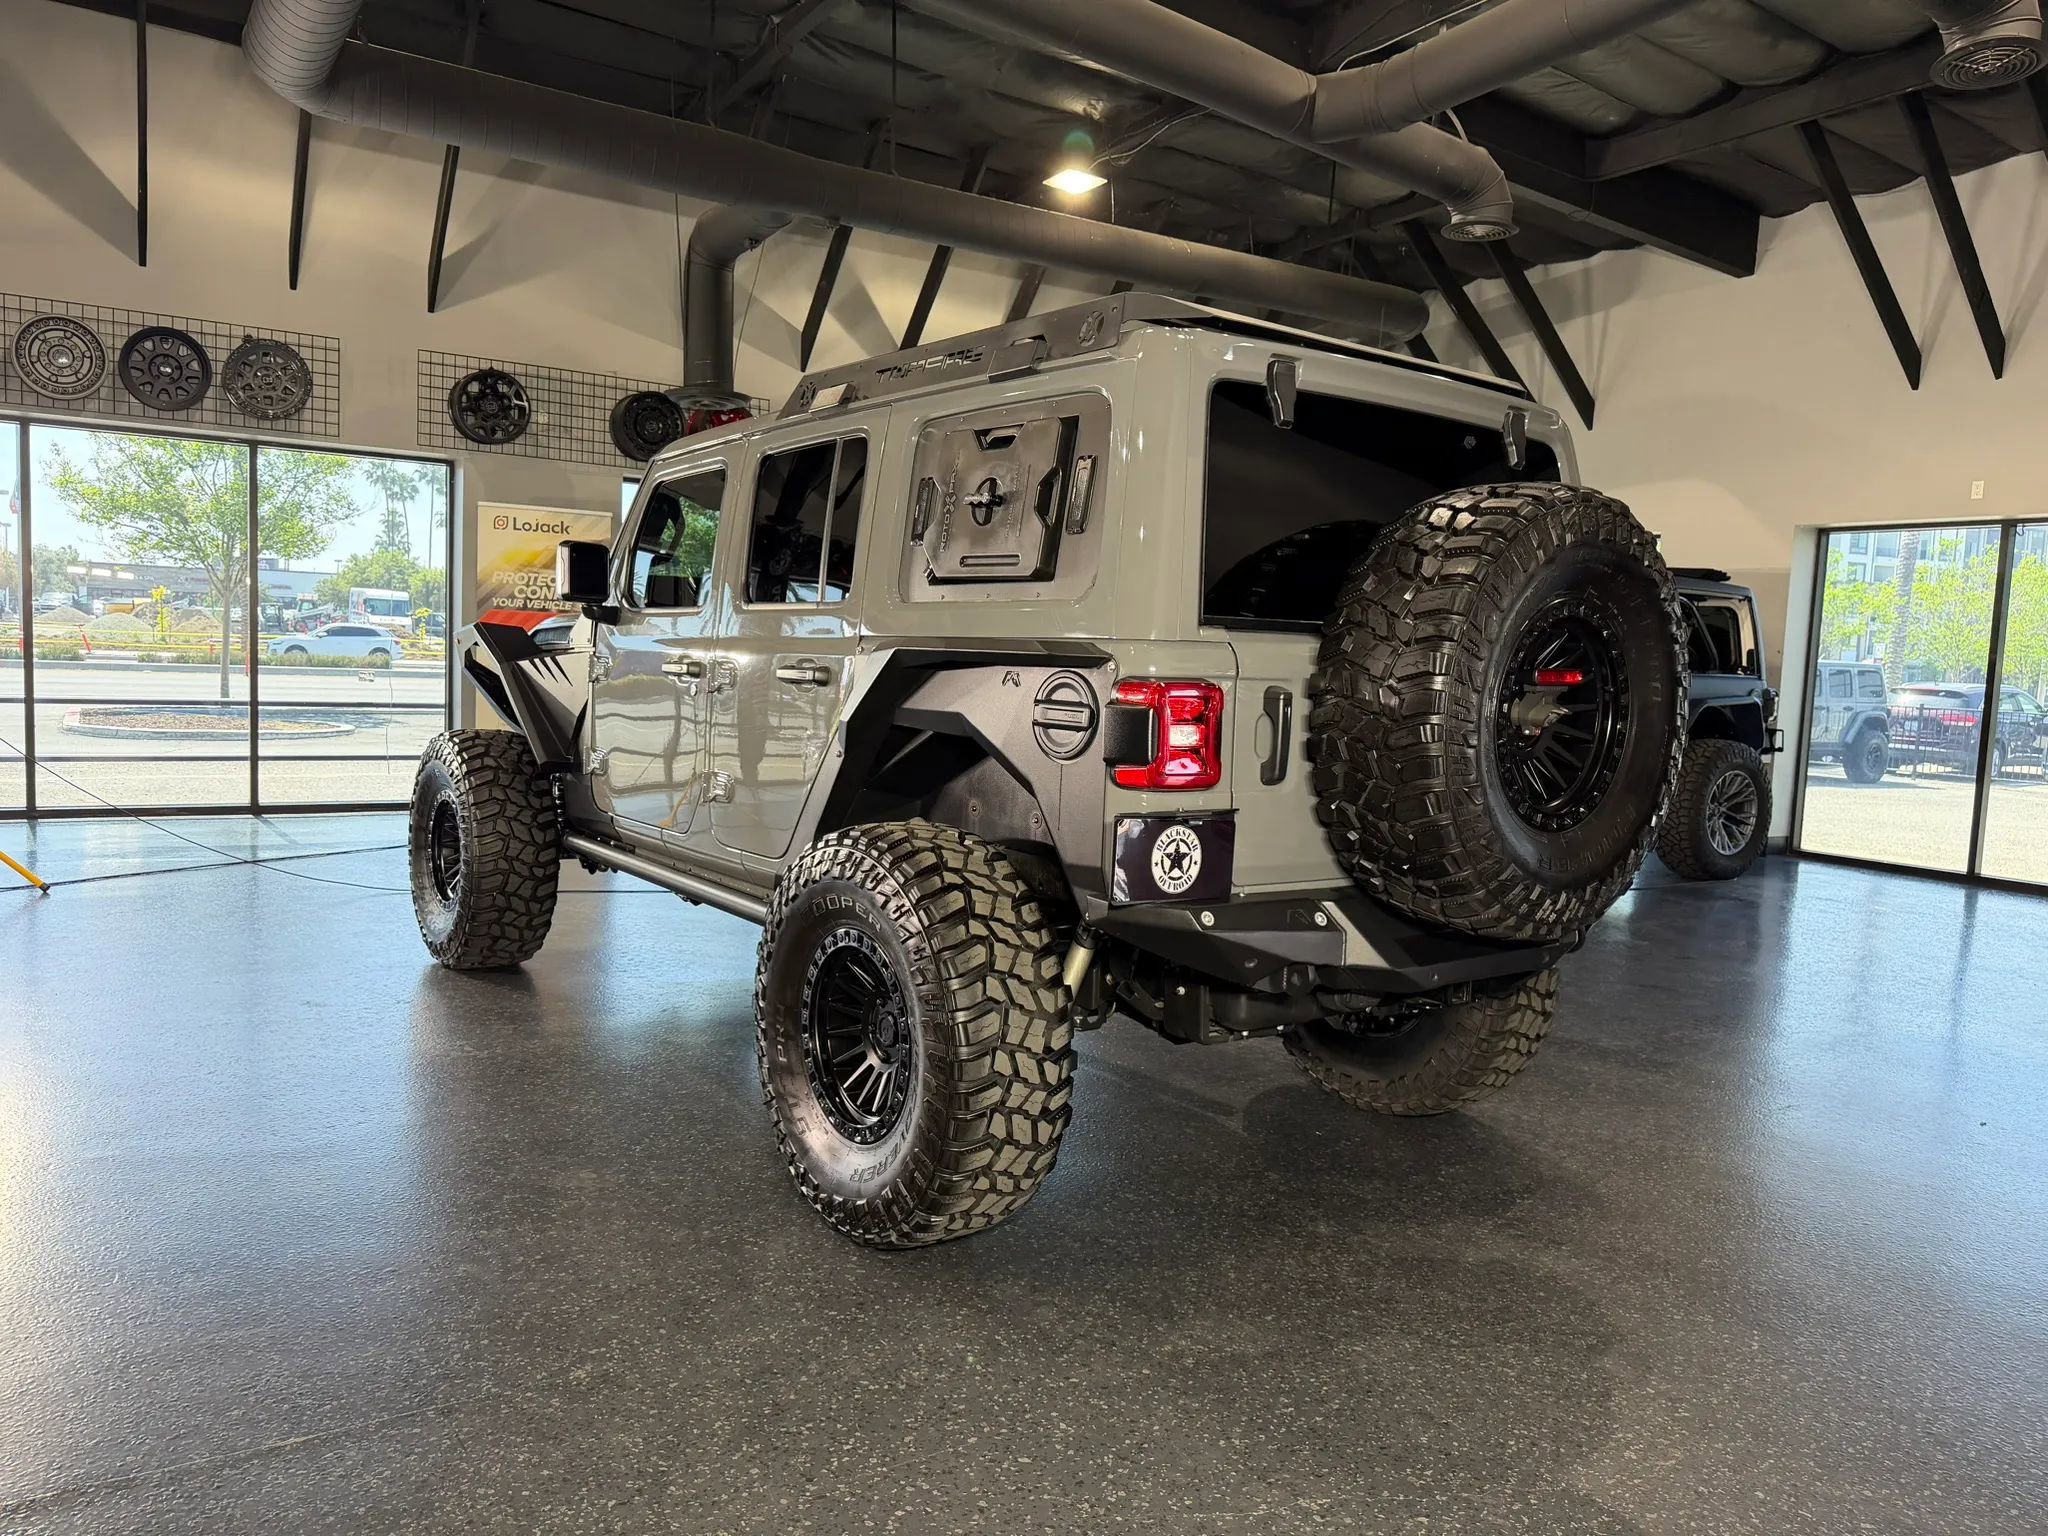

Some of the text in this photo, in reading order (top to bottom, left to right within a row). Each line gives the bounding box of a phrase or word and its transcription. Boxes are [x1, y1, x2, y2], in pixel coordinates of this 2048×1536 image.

[492, 571, 557, 587] PROTEC
[492, 597, 573, 610] YOUR VEHICLE
[1156, 828, 1199, 852] BLACKSTAR
